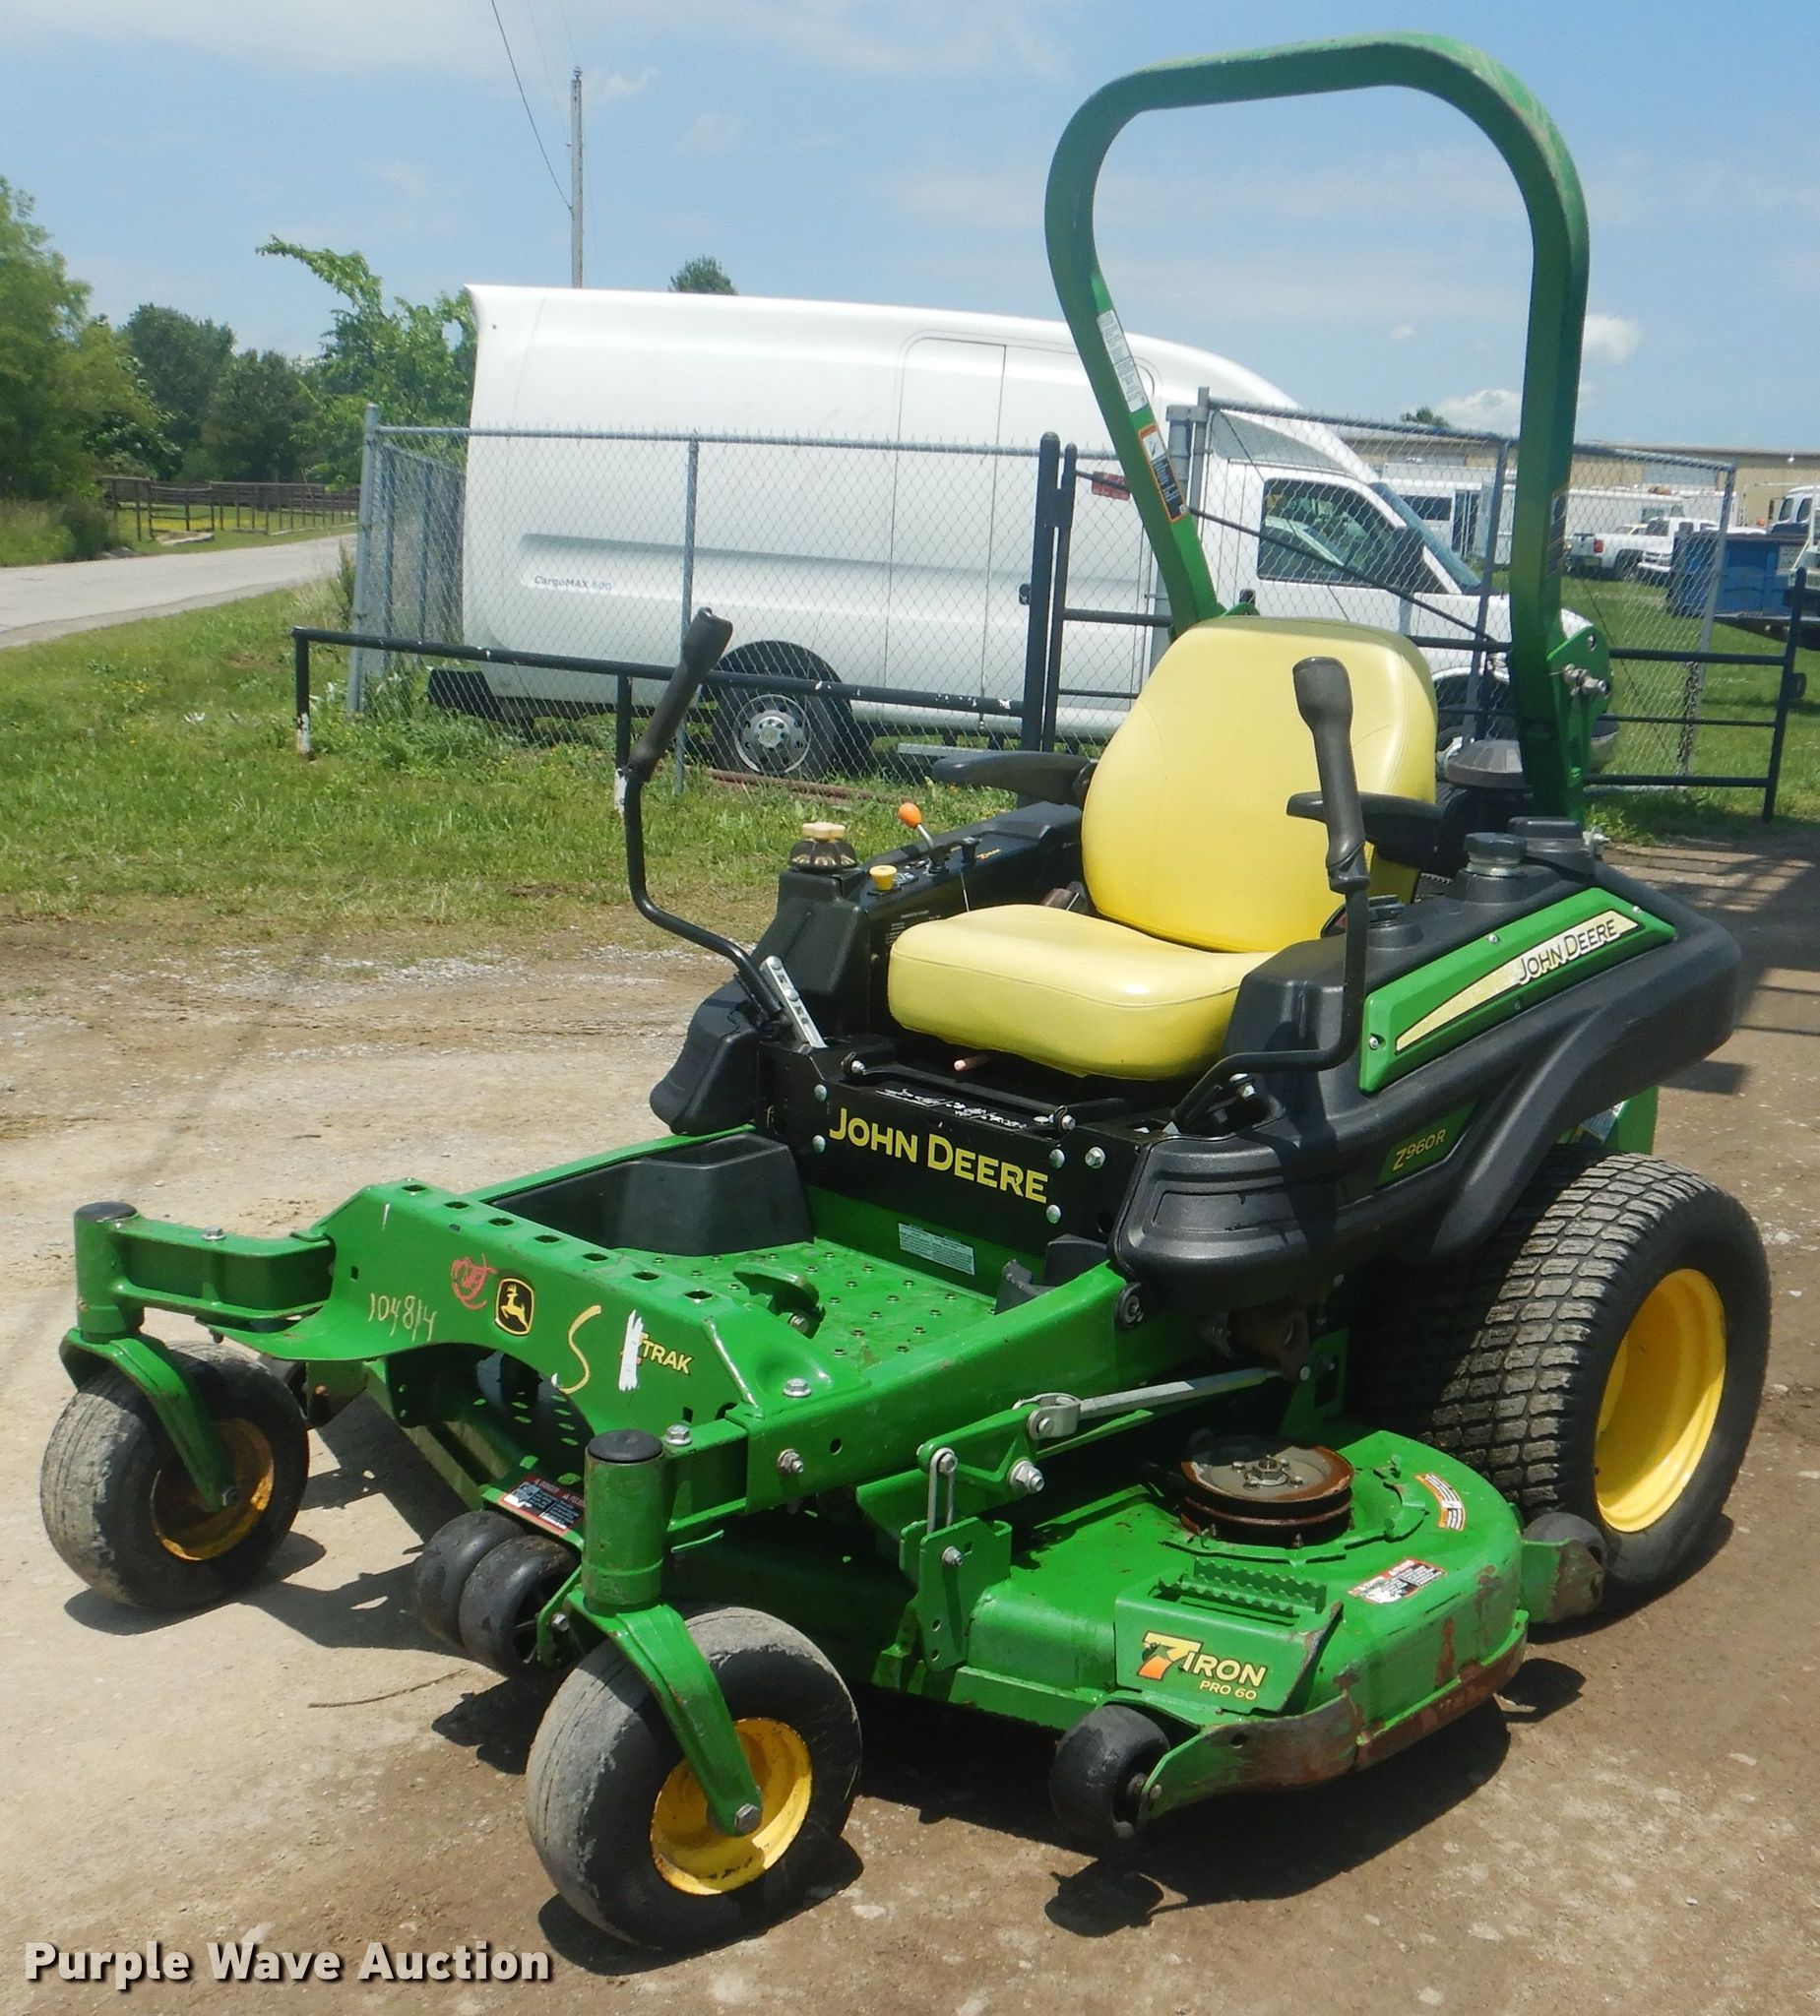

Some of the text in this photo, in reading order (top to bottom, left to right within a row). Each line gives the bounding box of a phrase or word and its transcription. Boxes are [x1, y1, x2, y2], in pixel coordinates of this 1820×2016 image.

[534, 575, 588, 589] CargoMAX
[1520, 919, 1617, 982] JOHN DEERE
[829, 1107, 918, 1163] JOHN
[927, 1133, 1048, 1204] DEERE
[1393, 1129, 1446, 1171] Z960R
[621, 1332, 693, 1376] TRAK
[1199, 1679, 1257, 1700] PRO 60
